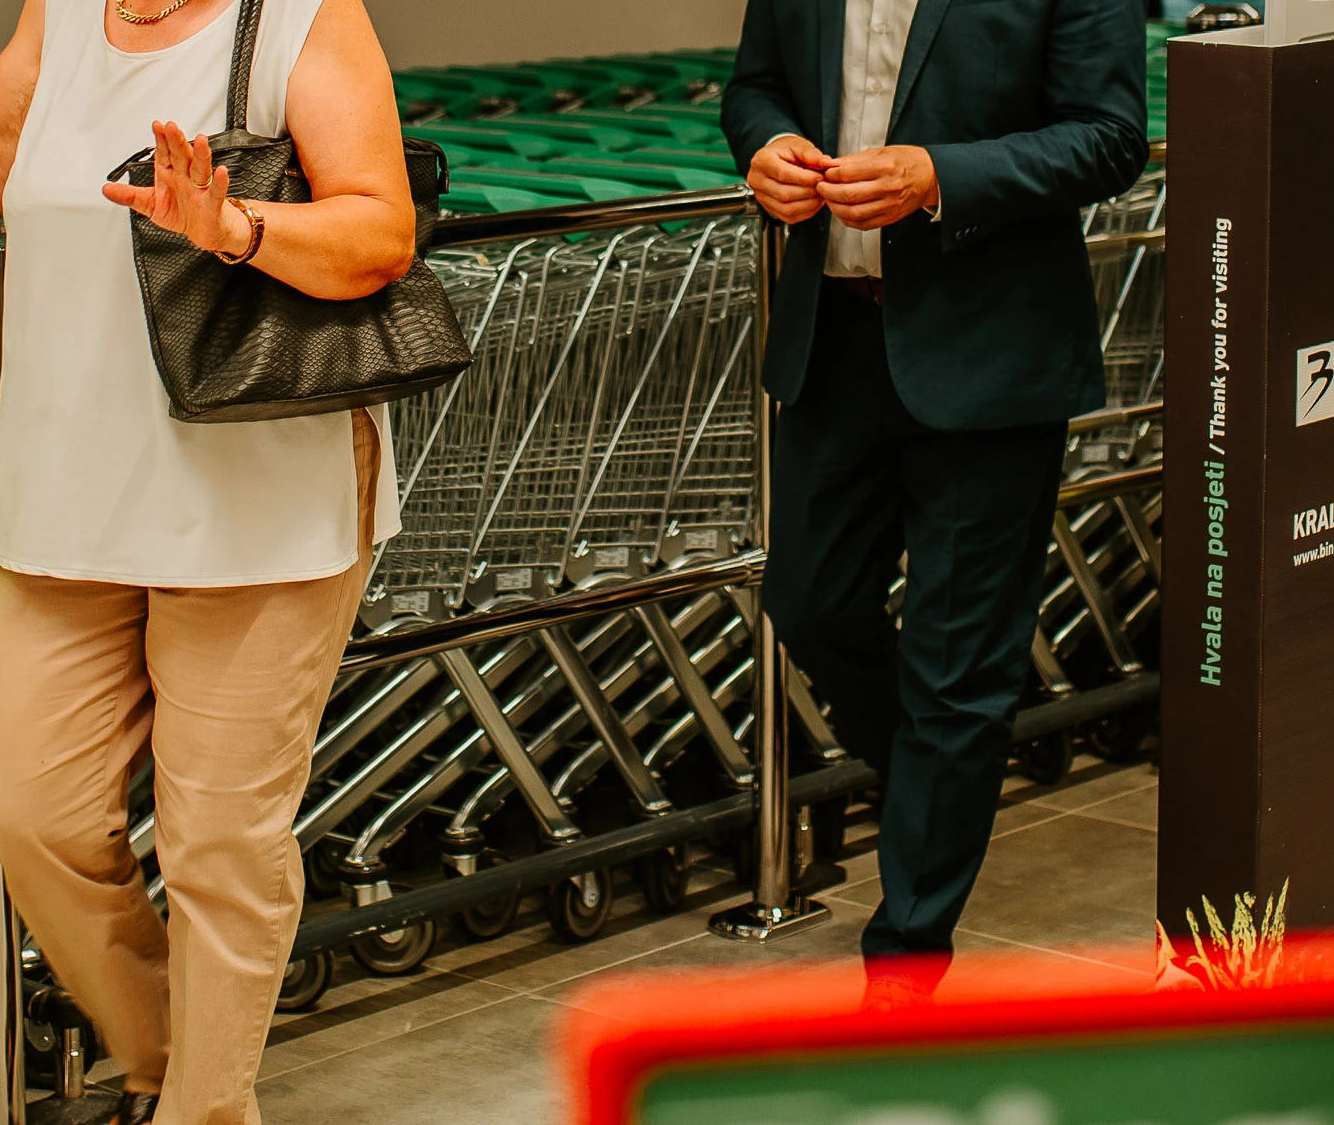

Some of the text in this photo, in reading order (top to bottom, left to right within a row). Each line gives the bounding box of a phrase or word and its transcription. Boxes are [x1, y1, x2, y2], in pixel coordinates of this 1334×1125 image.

[1212, 217, 1233, 294] visiting
[1211, 297, 1227, 329] for
[1214, 333, 1230, 372] you
[1209, 375, 1227, 439] Thank
[1203, 460, 1229, 557] posjeti
[1207, 563, 1224, 598] na
[1200, 605, 1223, 686] Hvala
